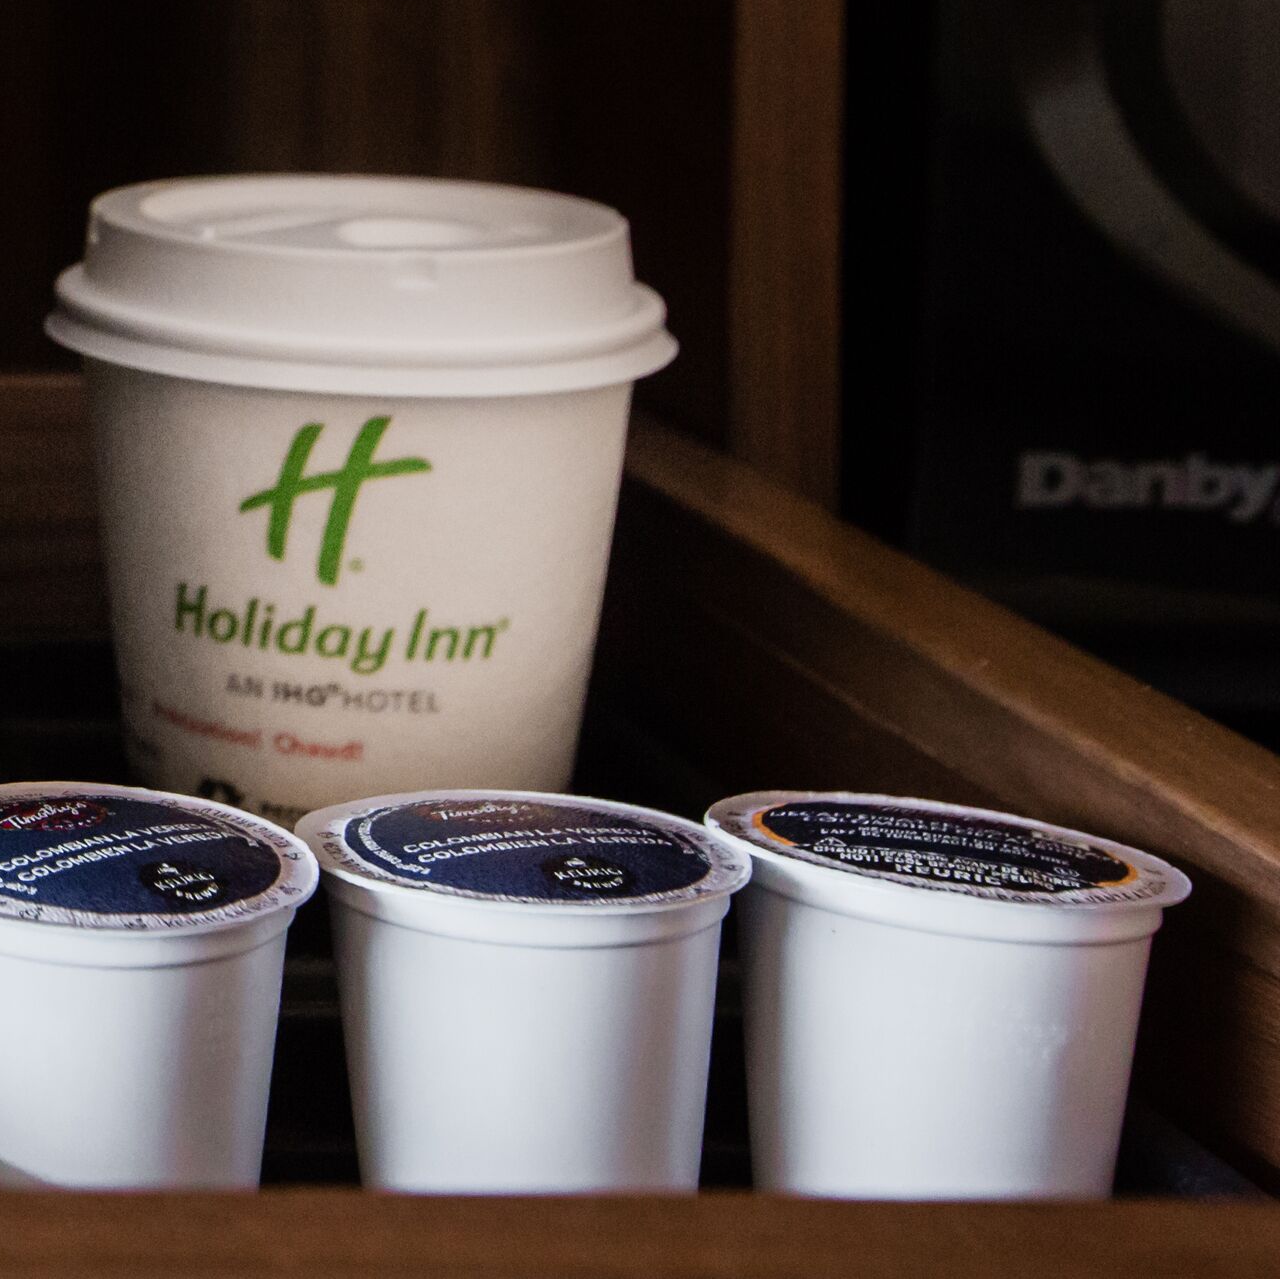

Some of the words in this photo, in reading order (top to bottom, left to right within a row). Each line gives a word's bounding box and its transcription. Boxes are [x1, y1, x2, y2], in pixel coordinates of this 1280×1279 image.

[174, 580, 394, 676] Holiday
[225, 672, 264, 699] AN
[341, 688, 440, 714] HOTEL
[109, 828, 140, 841] LA
[402, 829, 535, 853] COLOMBIAN
[533, 827, 563, 837] LA
[16, 843, 134, 883] COLOMBIEN
[134, 838, 163, 852] LA
[417, 838, 551, 863] COLOMBIEN
[549, 836, 581, 846] LA
[895, 863, 1002, 886] KEURIG
[953, 857, 998, 871] AVANT
